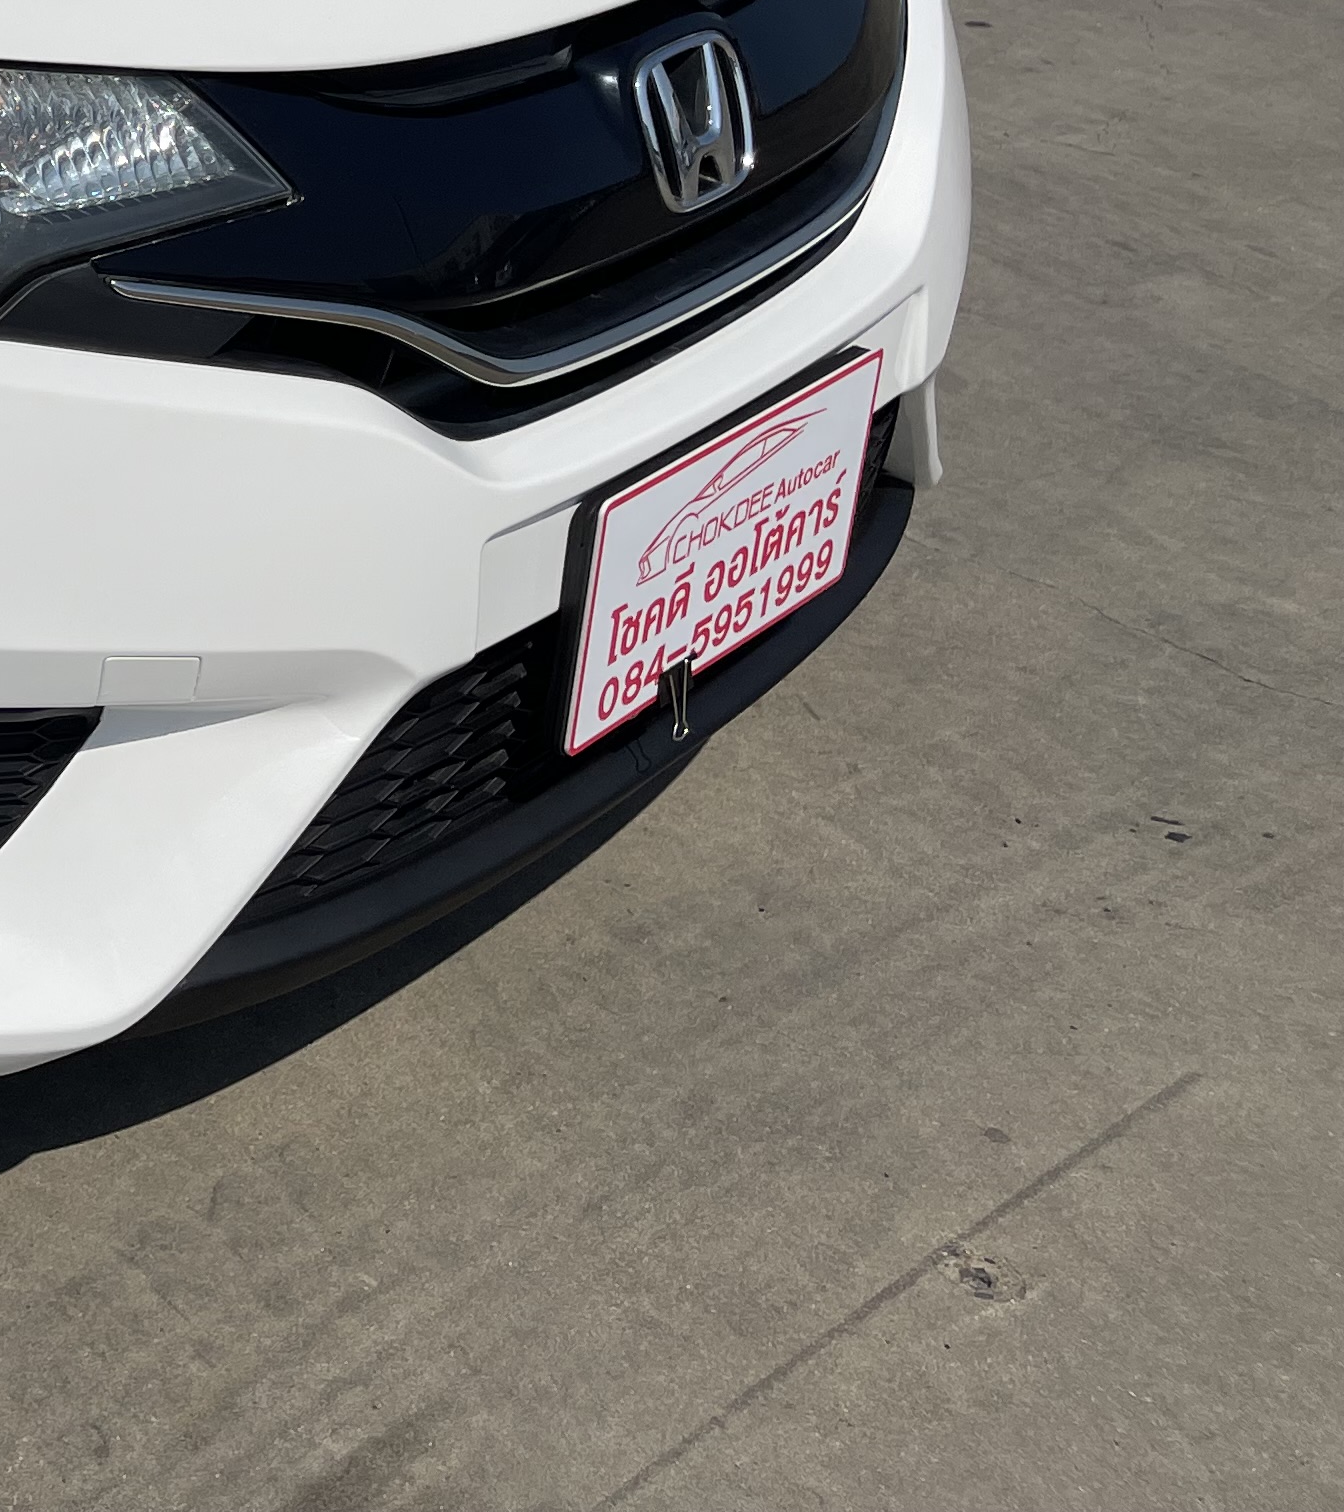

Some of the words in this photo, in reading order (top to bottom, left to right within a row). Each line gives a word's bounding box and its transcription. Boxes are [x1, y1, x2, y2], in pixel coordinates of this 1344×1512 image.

[607, 561, 695, 667] โชคดี
[703, 468, 847, 604] ออโต้คาร์
[673, 482, 774, 564] CHOKDEE
[774, 450, 840, 504] Autocar
[598, 539, 834, 721] 084-5951999
